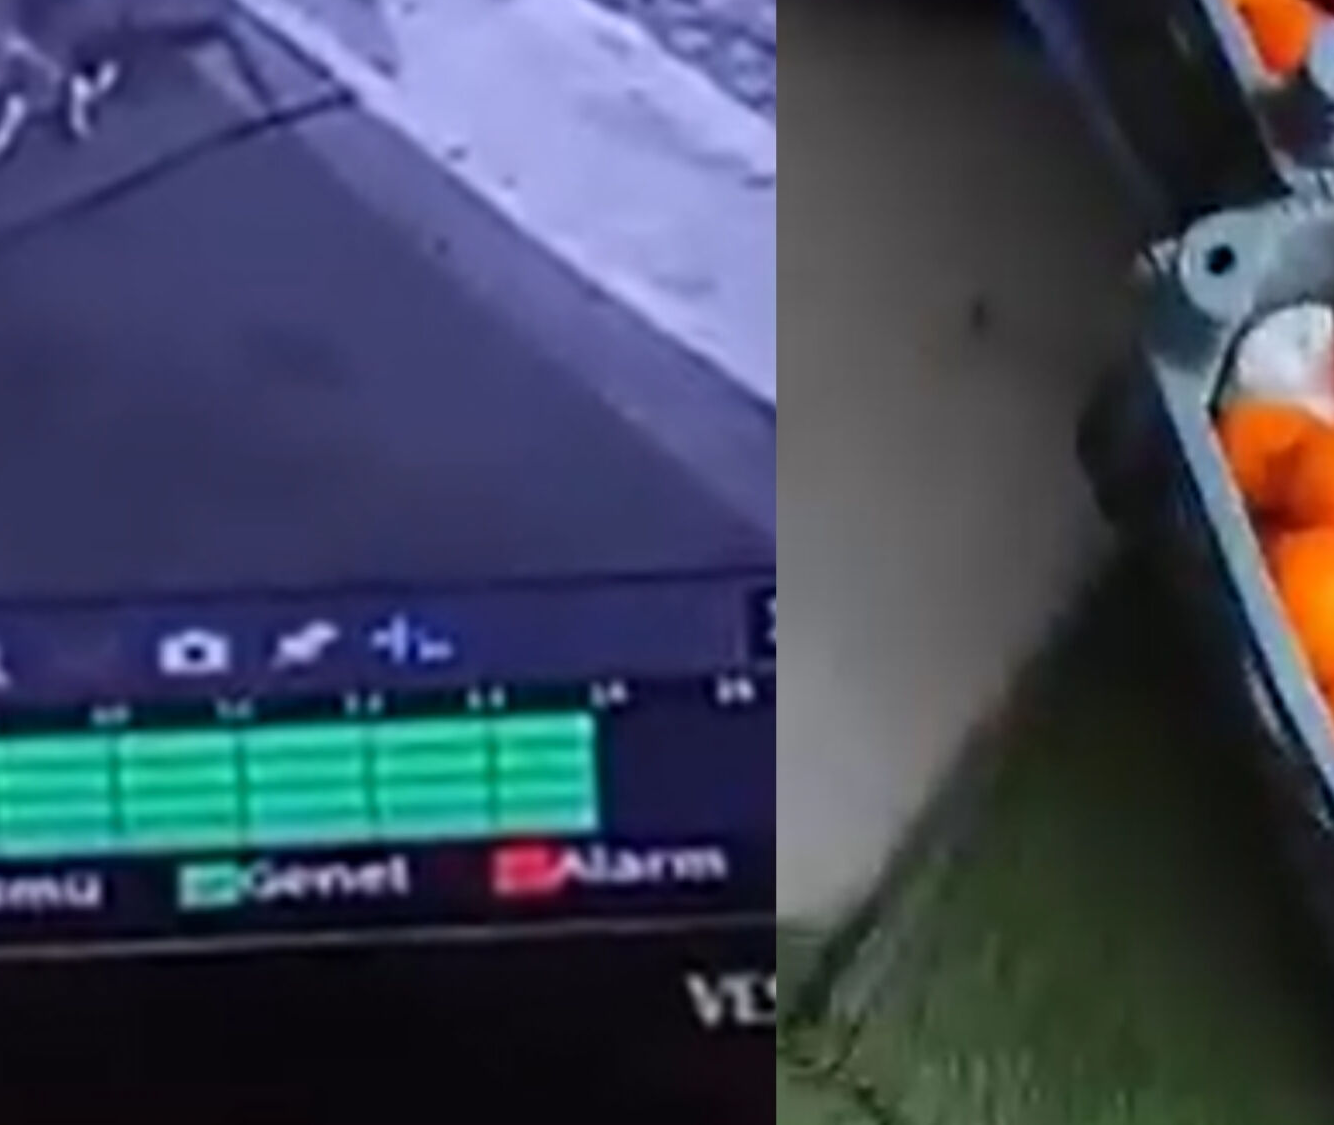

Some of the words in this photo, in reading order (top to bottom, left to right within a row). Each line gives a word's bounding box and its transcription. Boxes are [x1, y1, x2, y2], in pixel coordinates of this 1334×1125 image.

[245, 854, 411, 900] Genel
[553, 844, 729, 886] Alarm
[685, 971, 777, 1029] VE
